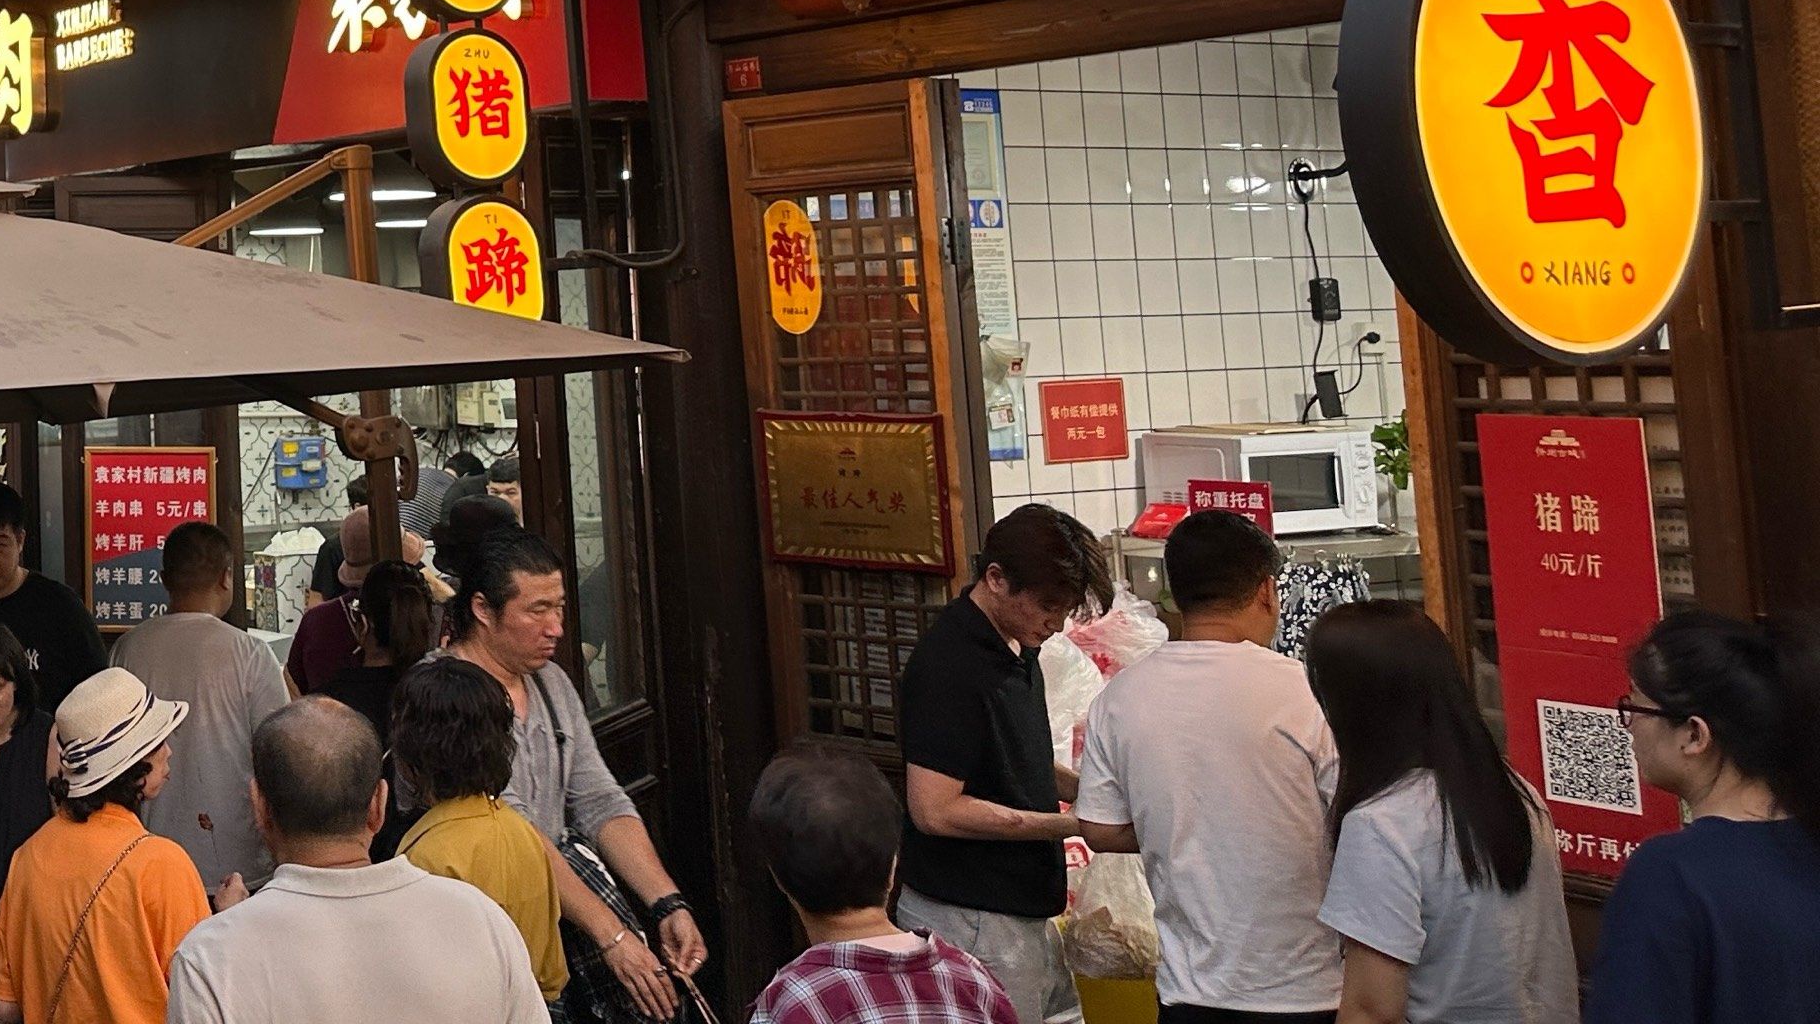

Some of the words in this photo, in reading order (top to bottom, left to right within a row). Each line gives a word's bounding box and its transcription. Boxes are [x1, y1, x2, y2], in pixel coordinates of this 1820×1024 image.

[464, 48, 490, 59] ZHU
[446, 65, 513, 139] 猪
[461, 228, 529, 306] 蹄
[1543, 260, 1611, 286] XIANG
[1067, 426, 1107, 441] 两元一包
[95, 466, 207, 485] 袁家村新疆烤肉
[95, 500, 143, 517] 羊肉串
[156, 500, 207, 517] 5元/串
[801, 486, 906, 514] 最佳人气奖
[1195, 490, 1265, 509] 称重托盘
[1533, 492, 1601, 535] 猪蹄
[95, 534, 144, 551] 烤羊肝
[1540, 552, 1603, 578] 40元/斤
[95, 568, 143, 585] 烤羊腰
[95, 602, 143, 620] 烤羊蛋
